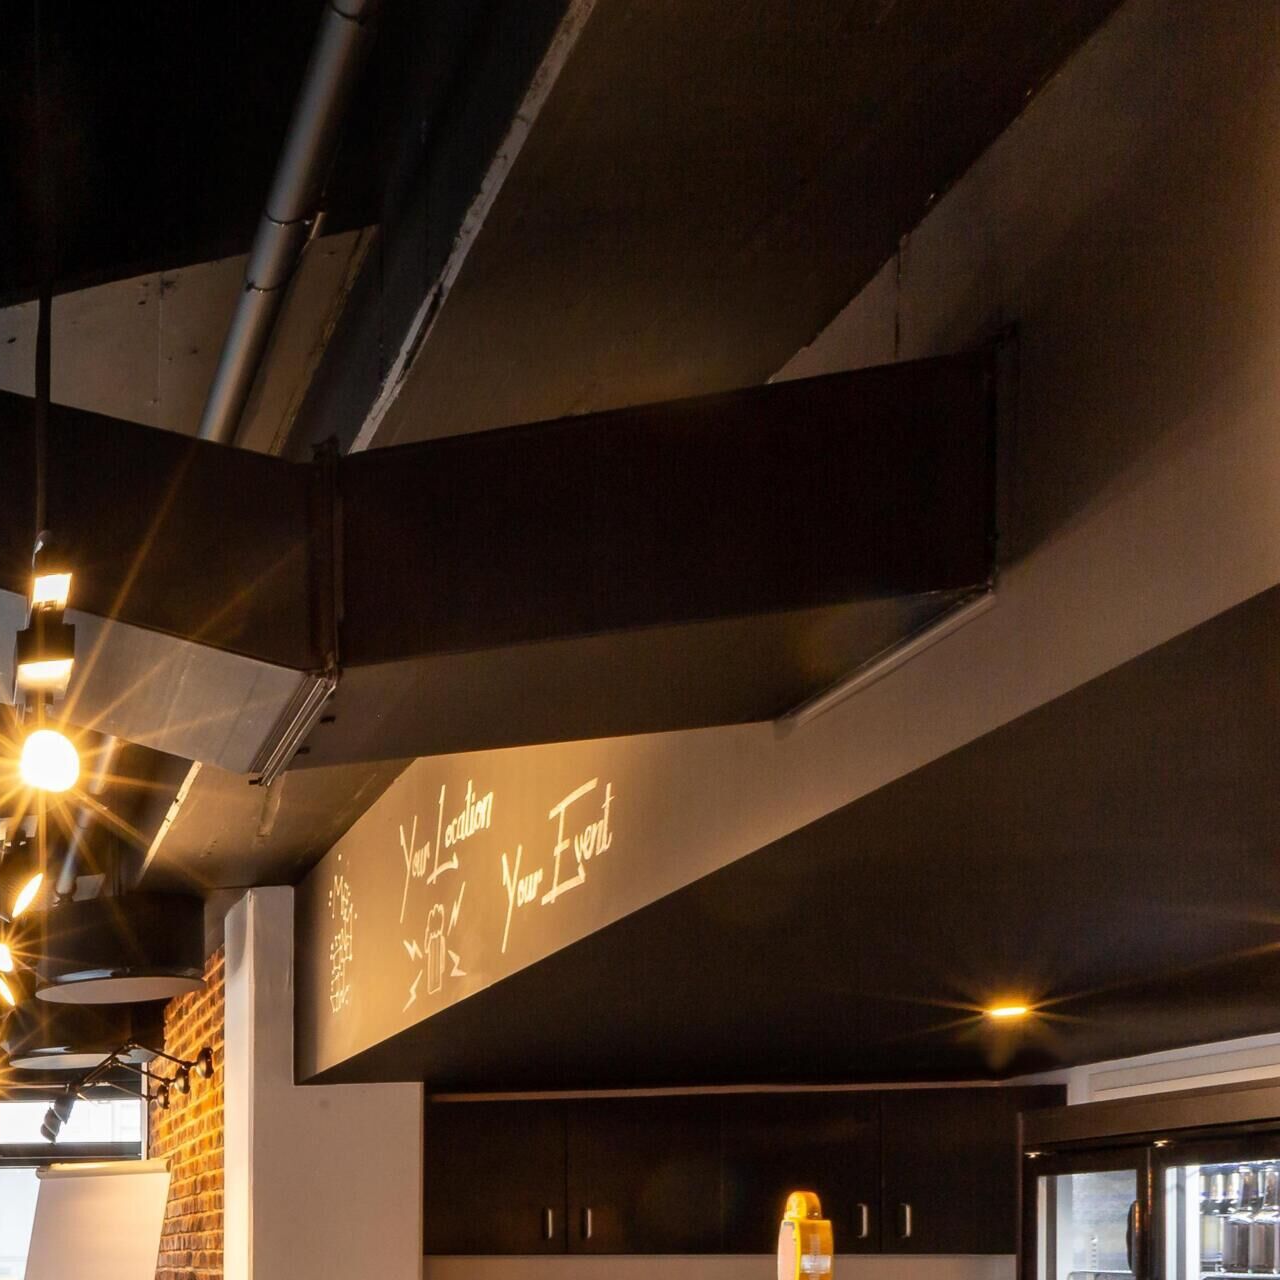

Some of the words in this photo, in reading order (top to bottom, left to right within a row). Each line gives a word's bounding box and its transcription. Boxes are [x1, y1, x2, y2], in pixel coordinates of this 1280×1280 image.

[399, 815, 430, 923] Your
[426, 780, 493, 885] Location
[502, 845, 543, 953] Your
[542, 778, 615, 905] Event
